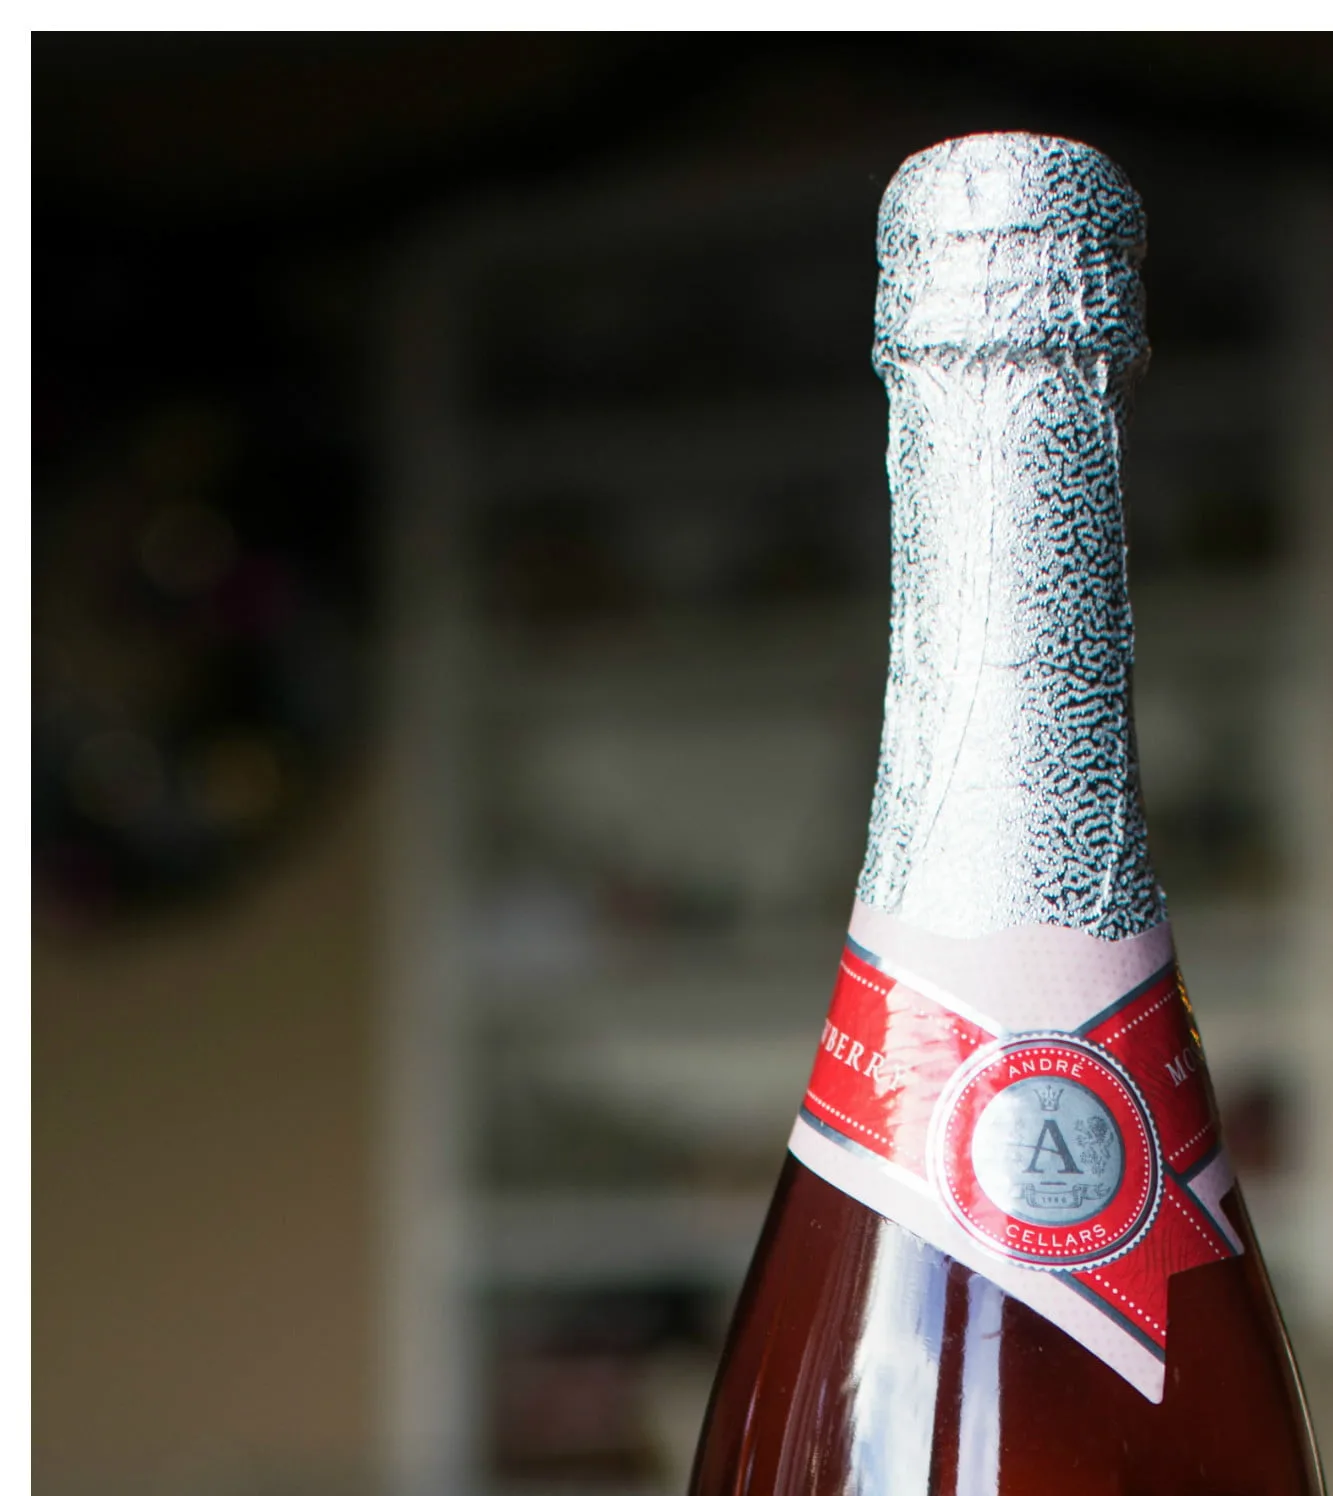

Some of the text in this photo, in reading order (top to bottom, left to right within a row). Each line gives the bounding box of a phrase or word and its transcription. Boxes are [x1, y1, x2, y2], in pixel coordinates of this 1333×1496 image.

[1008, 1058, 1084, 1079] ANDRÉ
[1022, 1118, 1084, 1174] A
[1006, 1224, 1106, 1247] CELLARS
